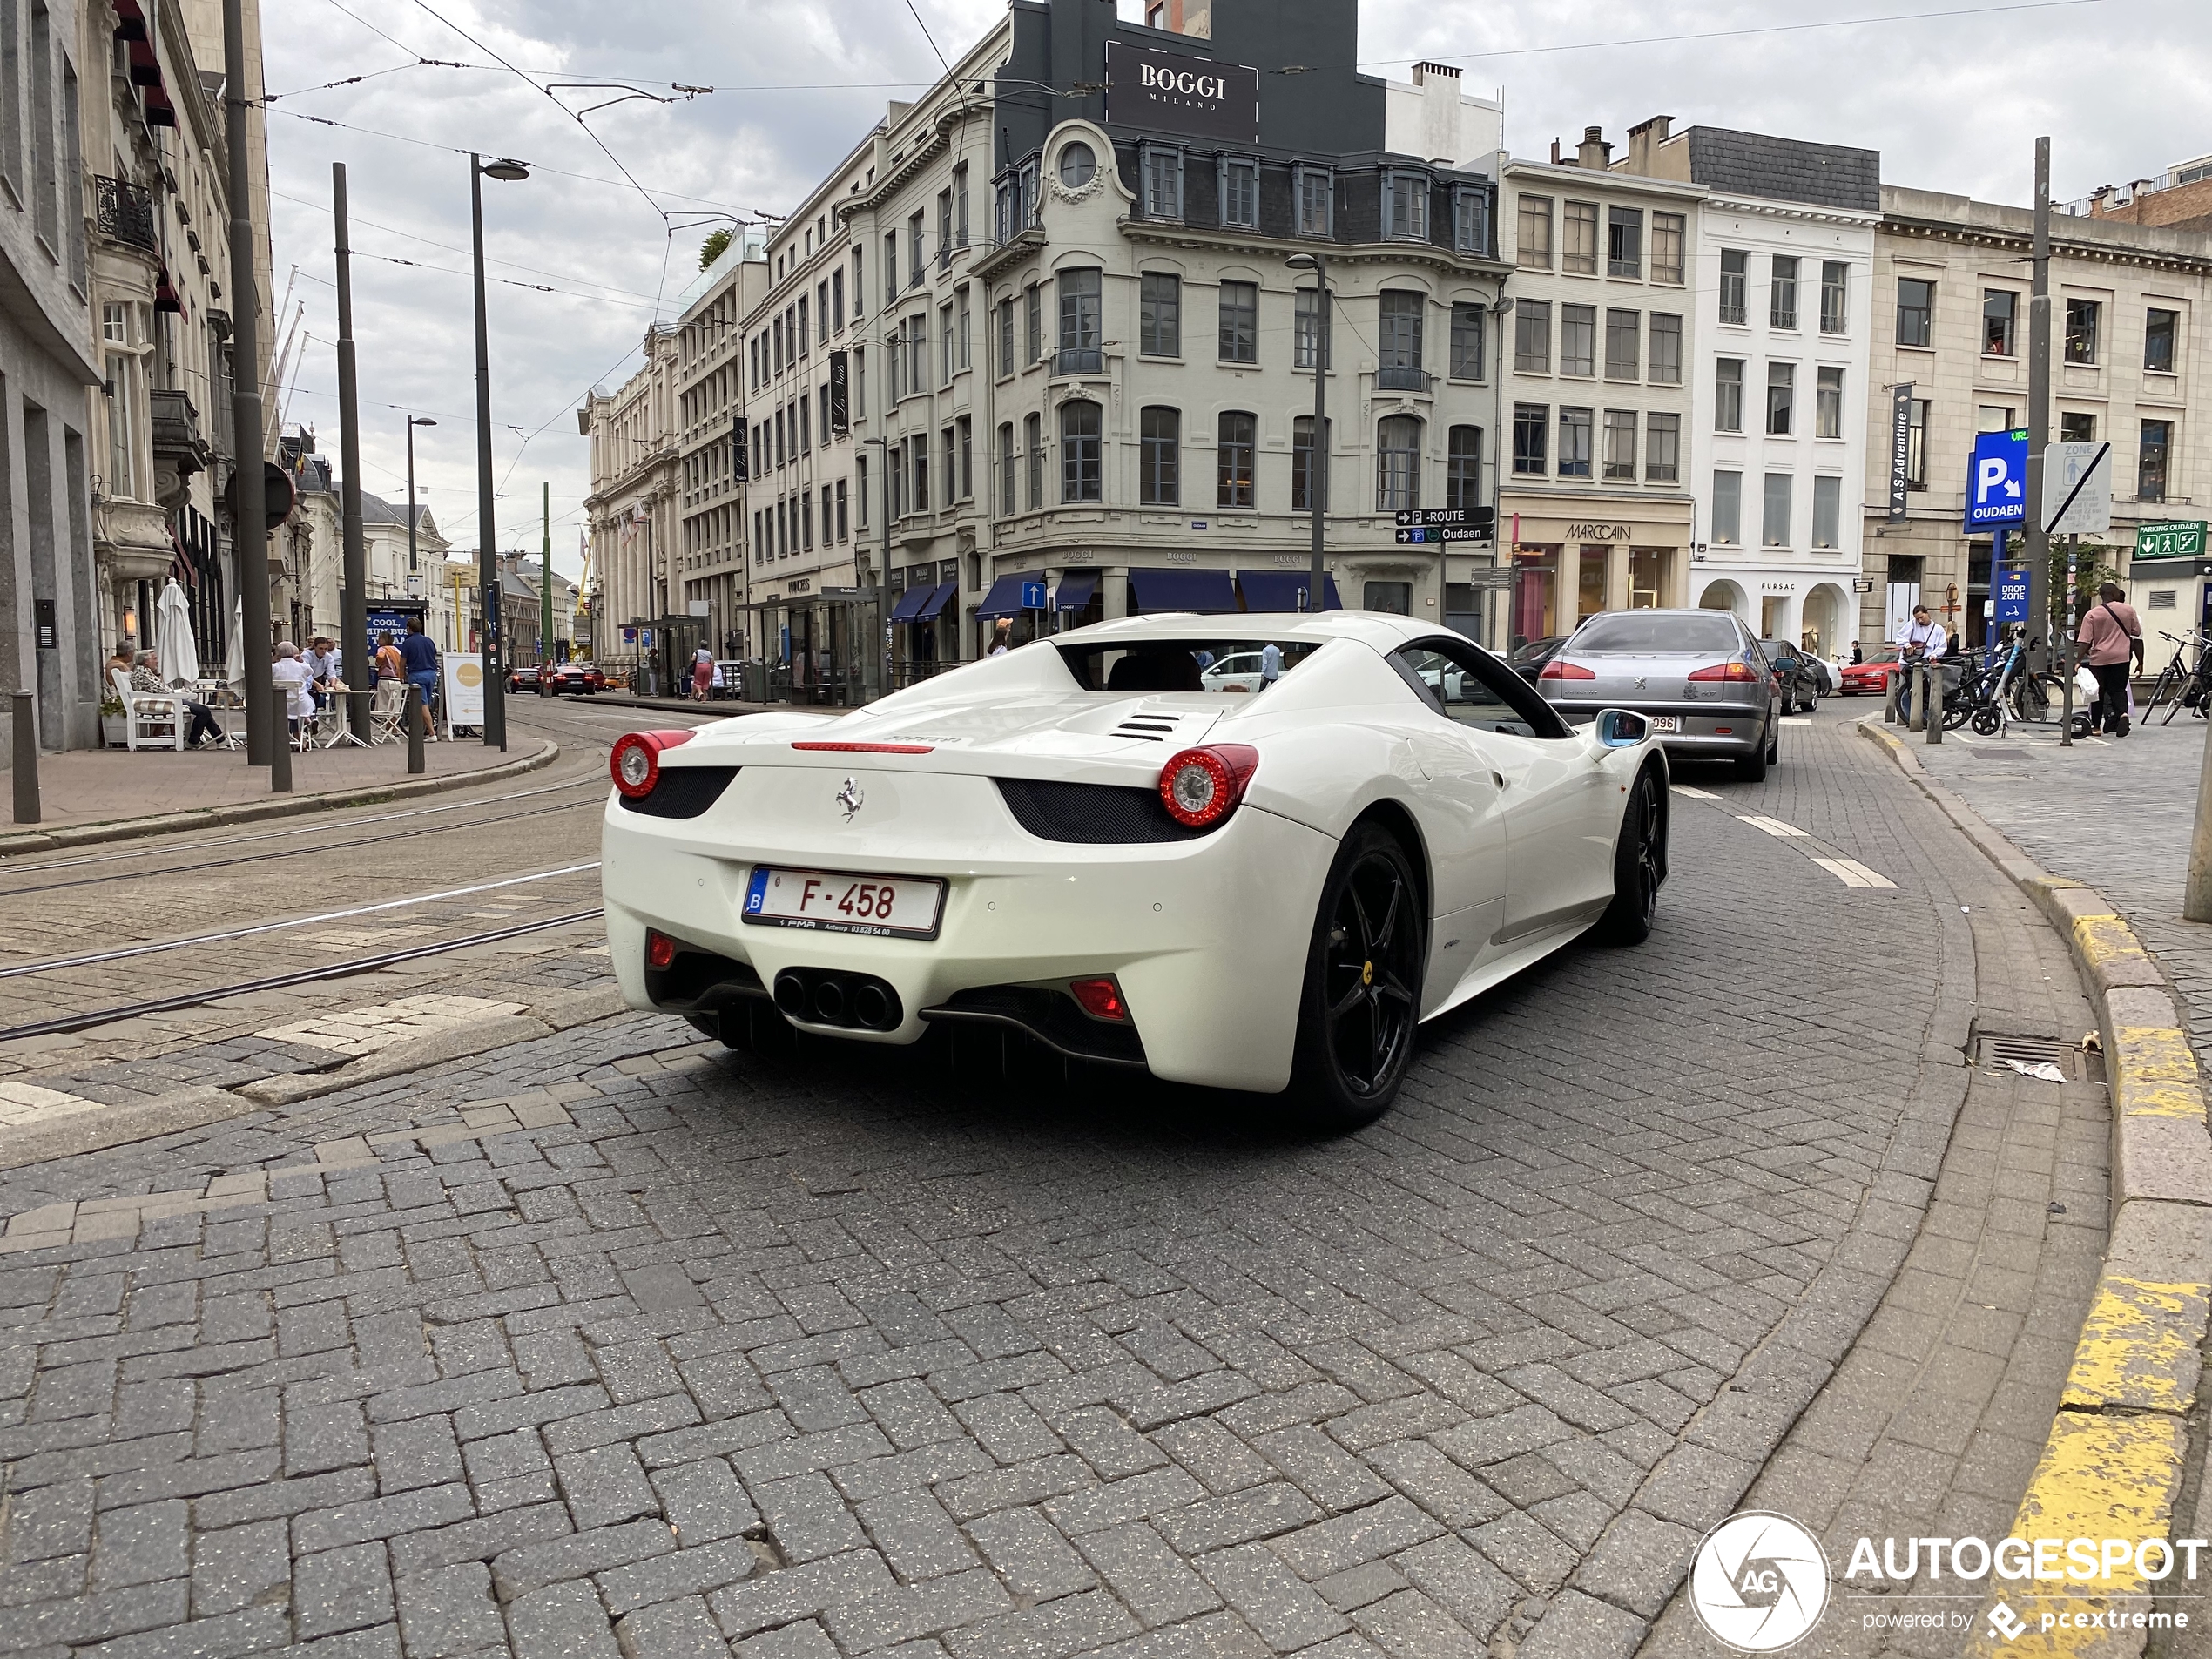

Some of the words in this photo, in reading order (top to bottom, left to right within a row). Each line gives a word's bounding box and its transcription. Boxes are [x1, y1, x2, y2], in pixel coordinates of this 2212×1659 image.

[1140, 64, 1225, 100] BOGGI
[1150, 93, 1216, 111] MILANO
[1893, 412, 1907, 501] A.S.Adventure
[2065, 445, 2094, 455] ZONE
[1977, 458, 2008, 503] P
[1973, 504, 2023, 519] OUDAEN
[1442, 529, 1481, 539] Oudaen
[2140, 524, 2168, 533] PARKING
[2169, 523, 2199, 531] OUDAEN
[1062, 550, 1093, 559] BOGGI
[1167, 552, 1197, 561] BOGGI
[1274, 555, 1302, 563] BOGGI
[750, 894, 761, 909] B
[799, 880, 895, 920] F-458
[787, 920, 816, 928] FMA
[825, 923, 848, 932] Antwerp
[851, 926, 872, 934] 03.828
